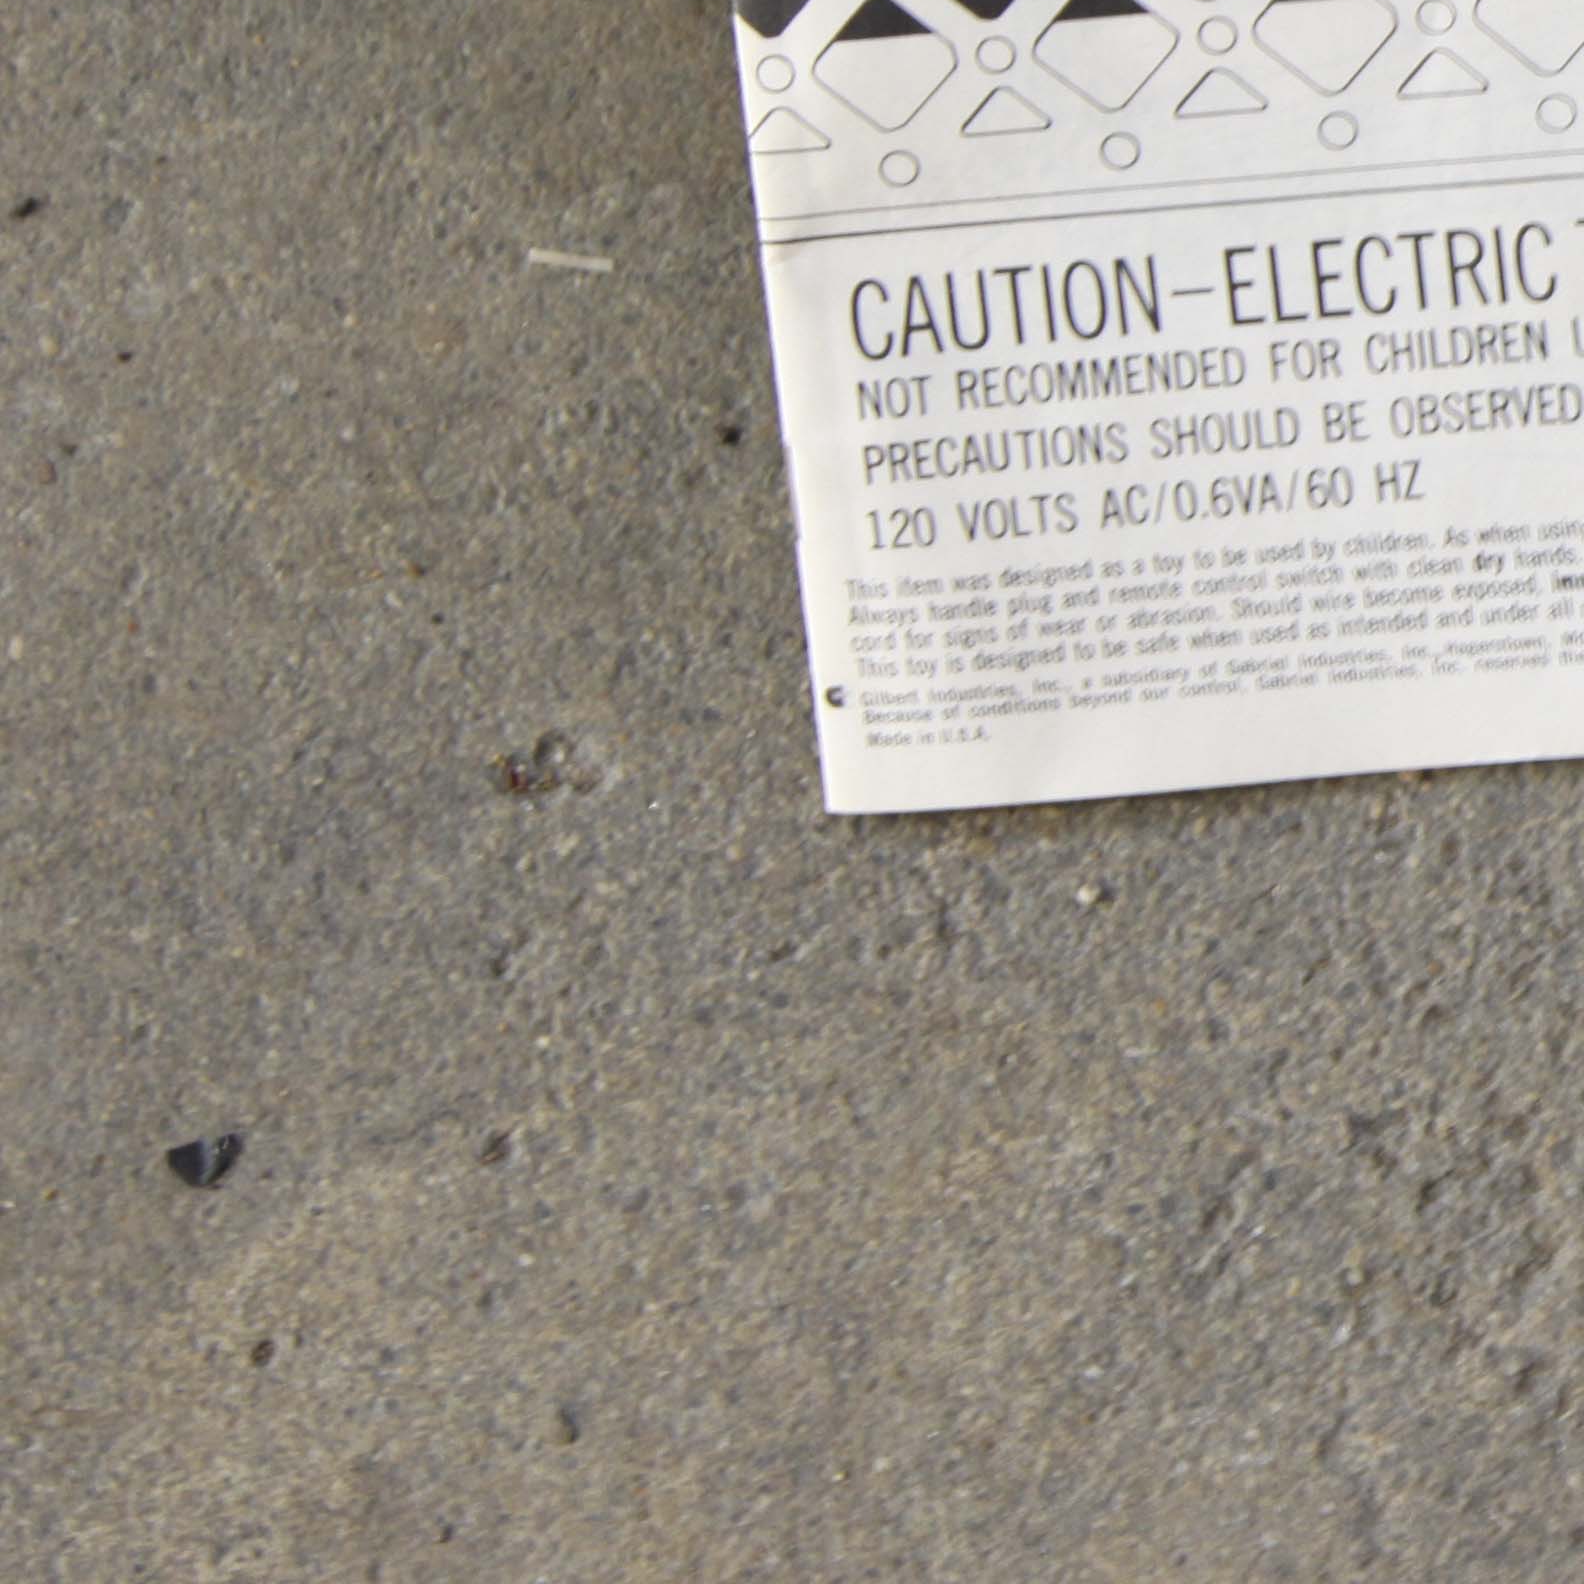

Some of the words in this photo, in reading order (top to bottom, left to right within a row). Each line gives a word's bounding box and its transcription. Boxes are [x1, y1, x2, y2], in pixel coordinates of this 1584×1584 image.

[856, 374, 932, 420] NOT
[954, 346, 1247, 411] RECOMMENDED
[1268, 337, 1343, 383] FOR
[1364, 319, 1550, 375] CHILDREN
[861, 422, 1130, 486] PRECAUTIONS
[1149, 406, 1301, 460] SHOULD
[1321, 400, 1371, 444] BE
[1389, 382, 1584, 439] OBSERVED
[866, 505, 938, 550] 120
[956, 492, 1079, 543] VOLTS
[1100, 466, 1355, 530] AC/0.6VA/60
[1373, 458, 1425, 504] HZ
